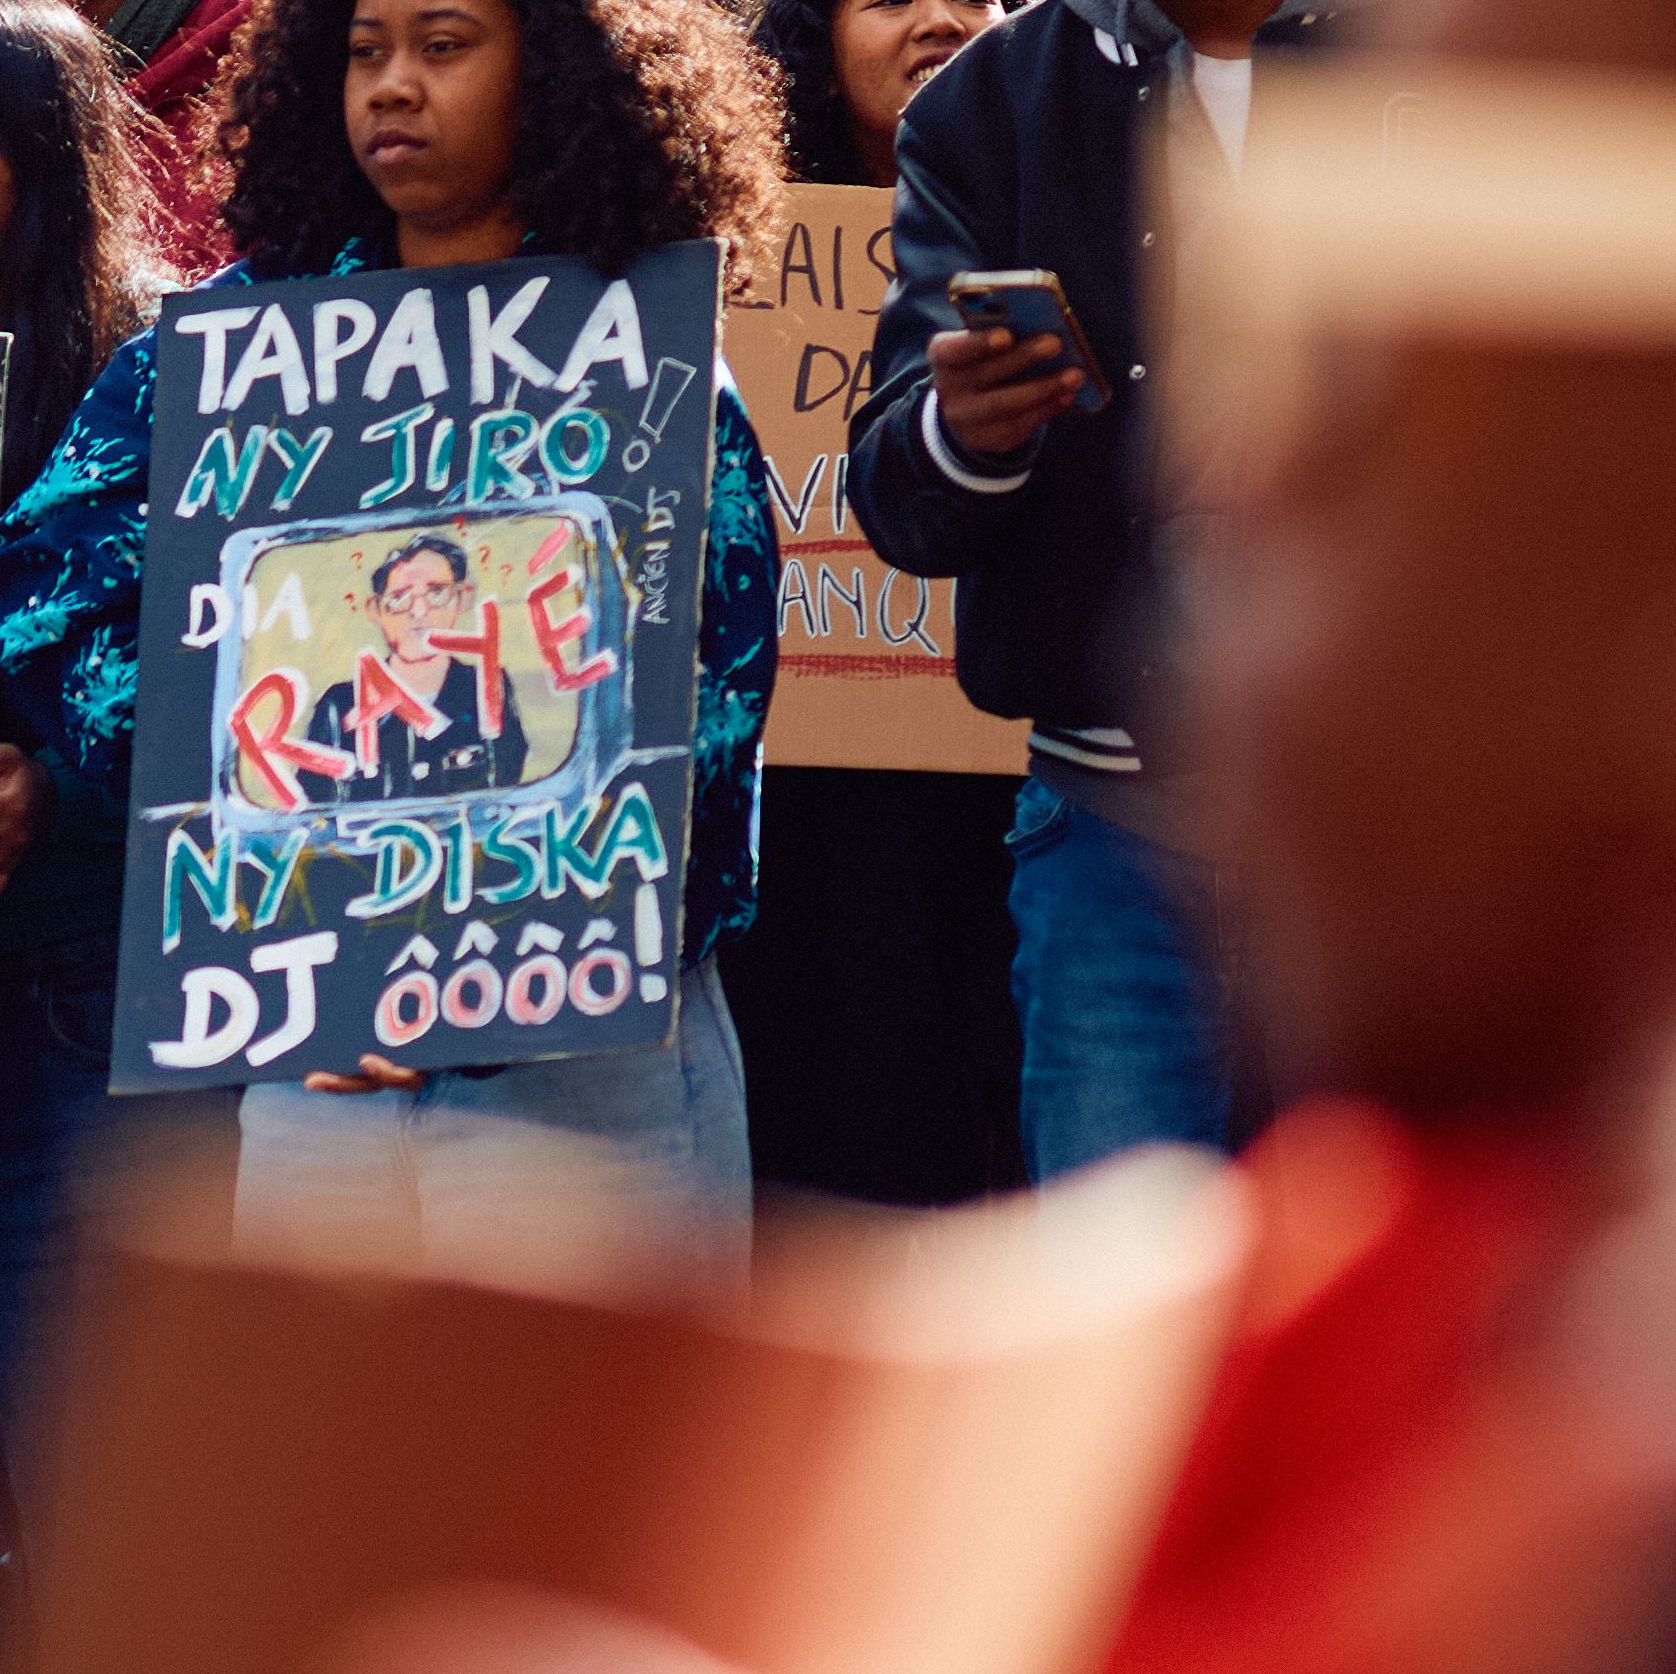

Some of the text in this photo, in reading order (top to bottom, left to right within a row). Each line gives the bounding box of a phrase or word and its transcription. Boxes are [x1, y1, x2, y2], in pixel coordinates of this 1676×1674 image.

[175, 276, 649, 415] TAPAKA
[175, 425, 333, 521] NY
[181, 572, 311, 649] DIA
[776, 558, 958, 657] ANQ
[163, 781, 669, 955] NY DISKA
[148, 930, 338, 1067] DJ
